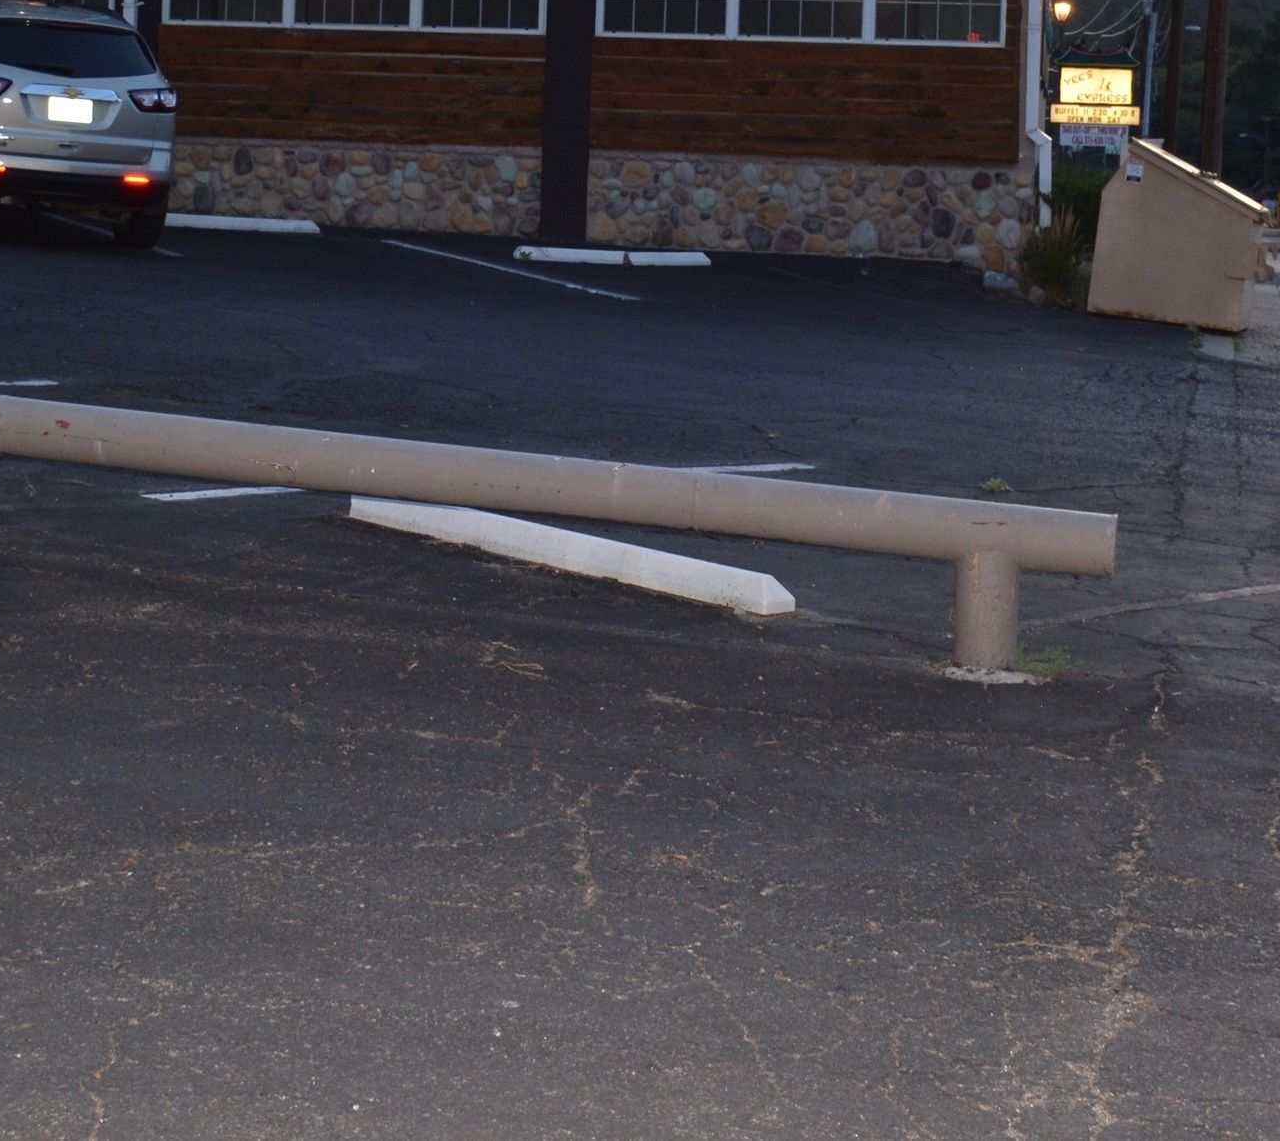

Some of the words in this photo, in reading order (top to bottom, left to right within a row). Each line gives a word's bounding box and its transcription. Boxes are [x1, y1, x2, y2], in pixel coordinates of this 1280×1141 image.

[1077, 92, 1128, 103] EXPRESS
[1054, 107, 1079, 115] BUFFET
[1066, 115, 1084, 123] OPEN
[1107, 116, 1121, 124] SAT
